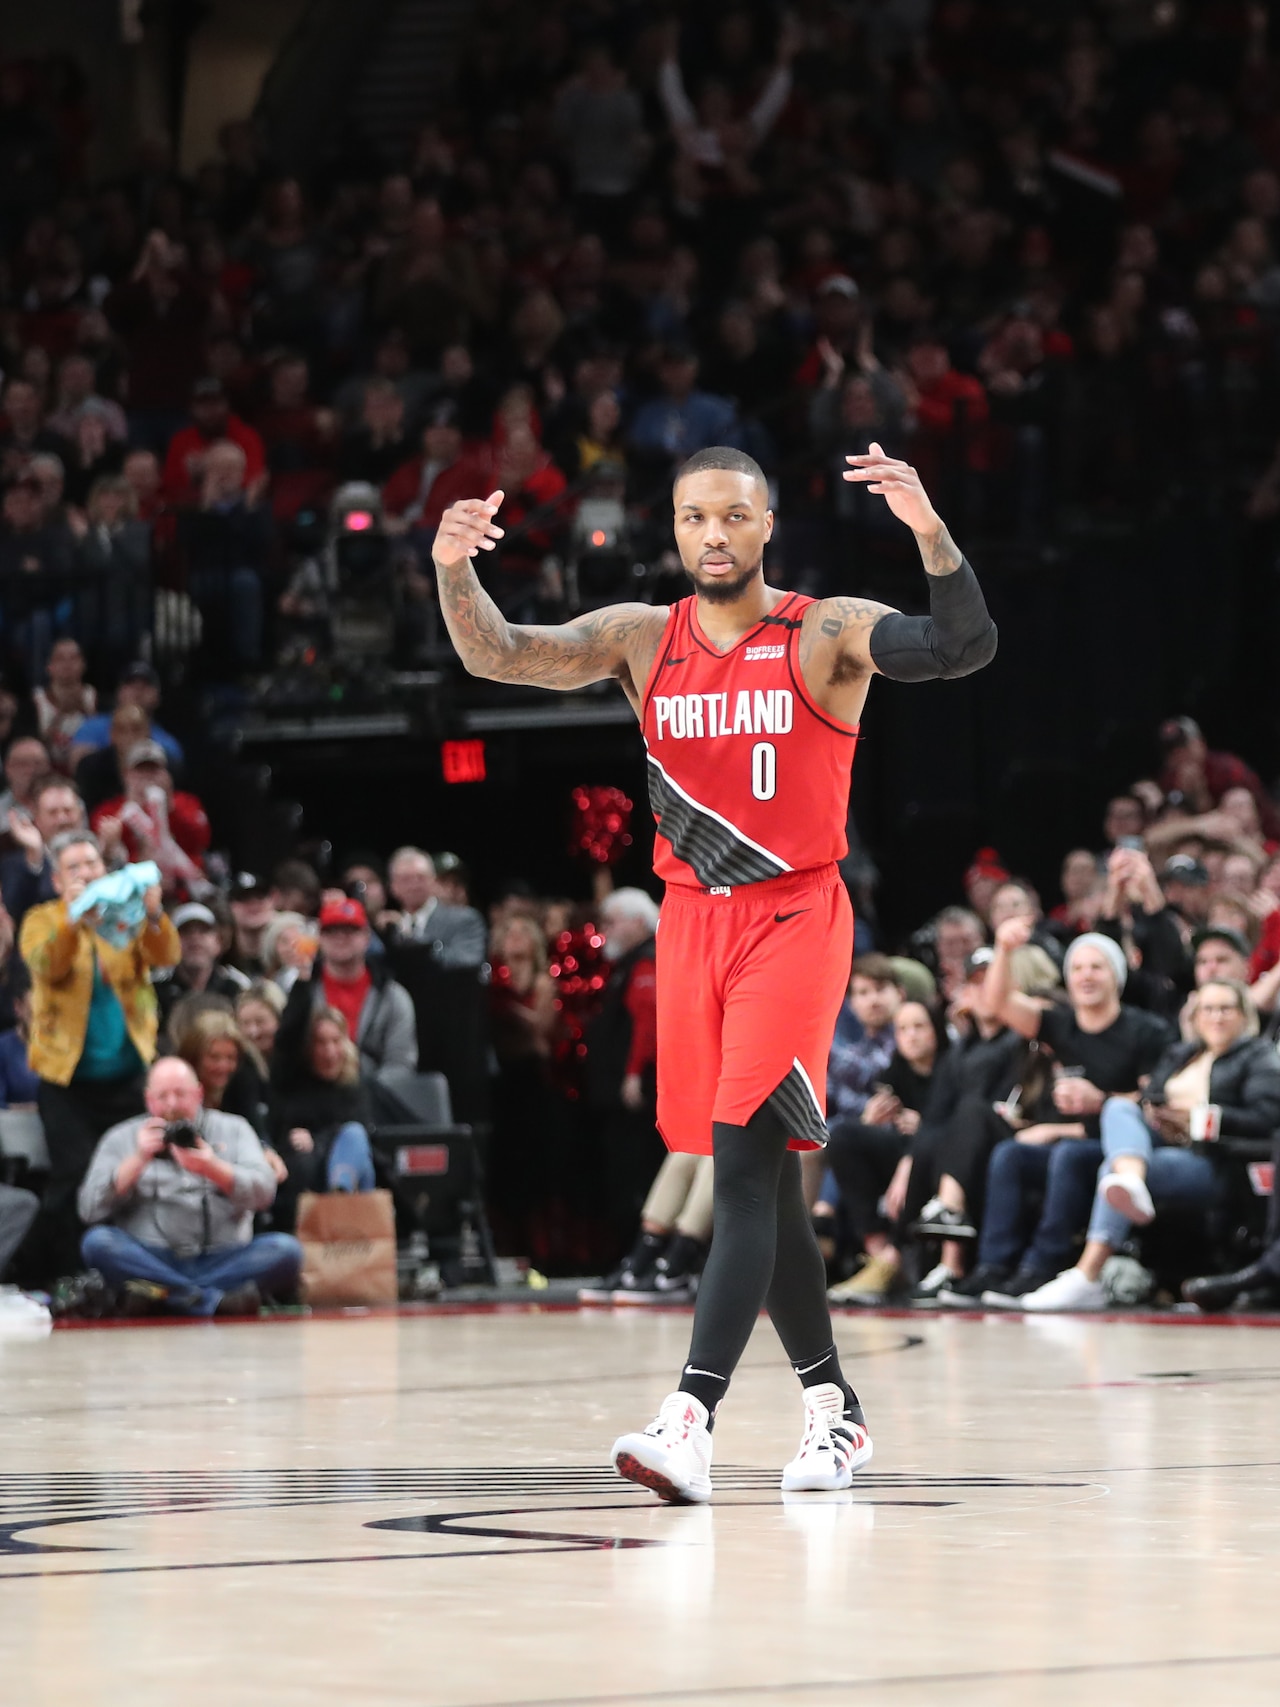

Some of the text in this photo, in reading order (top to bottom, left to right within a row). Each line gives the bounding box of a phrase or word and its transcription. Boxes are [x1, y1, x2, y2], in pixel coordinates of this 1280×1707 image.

[745, 644, 786, 655] BIOFREEZE
[652, 689, 793, 740] PORTLAND
[752, 741, 776, 801] 0
